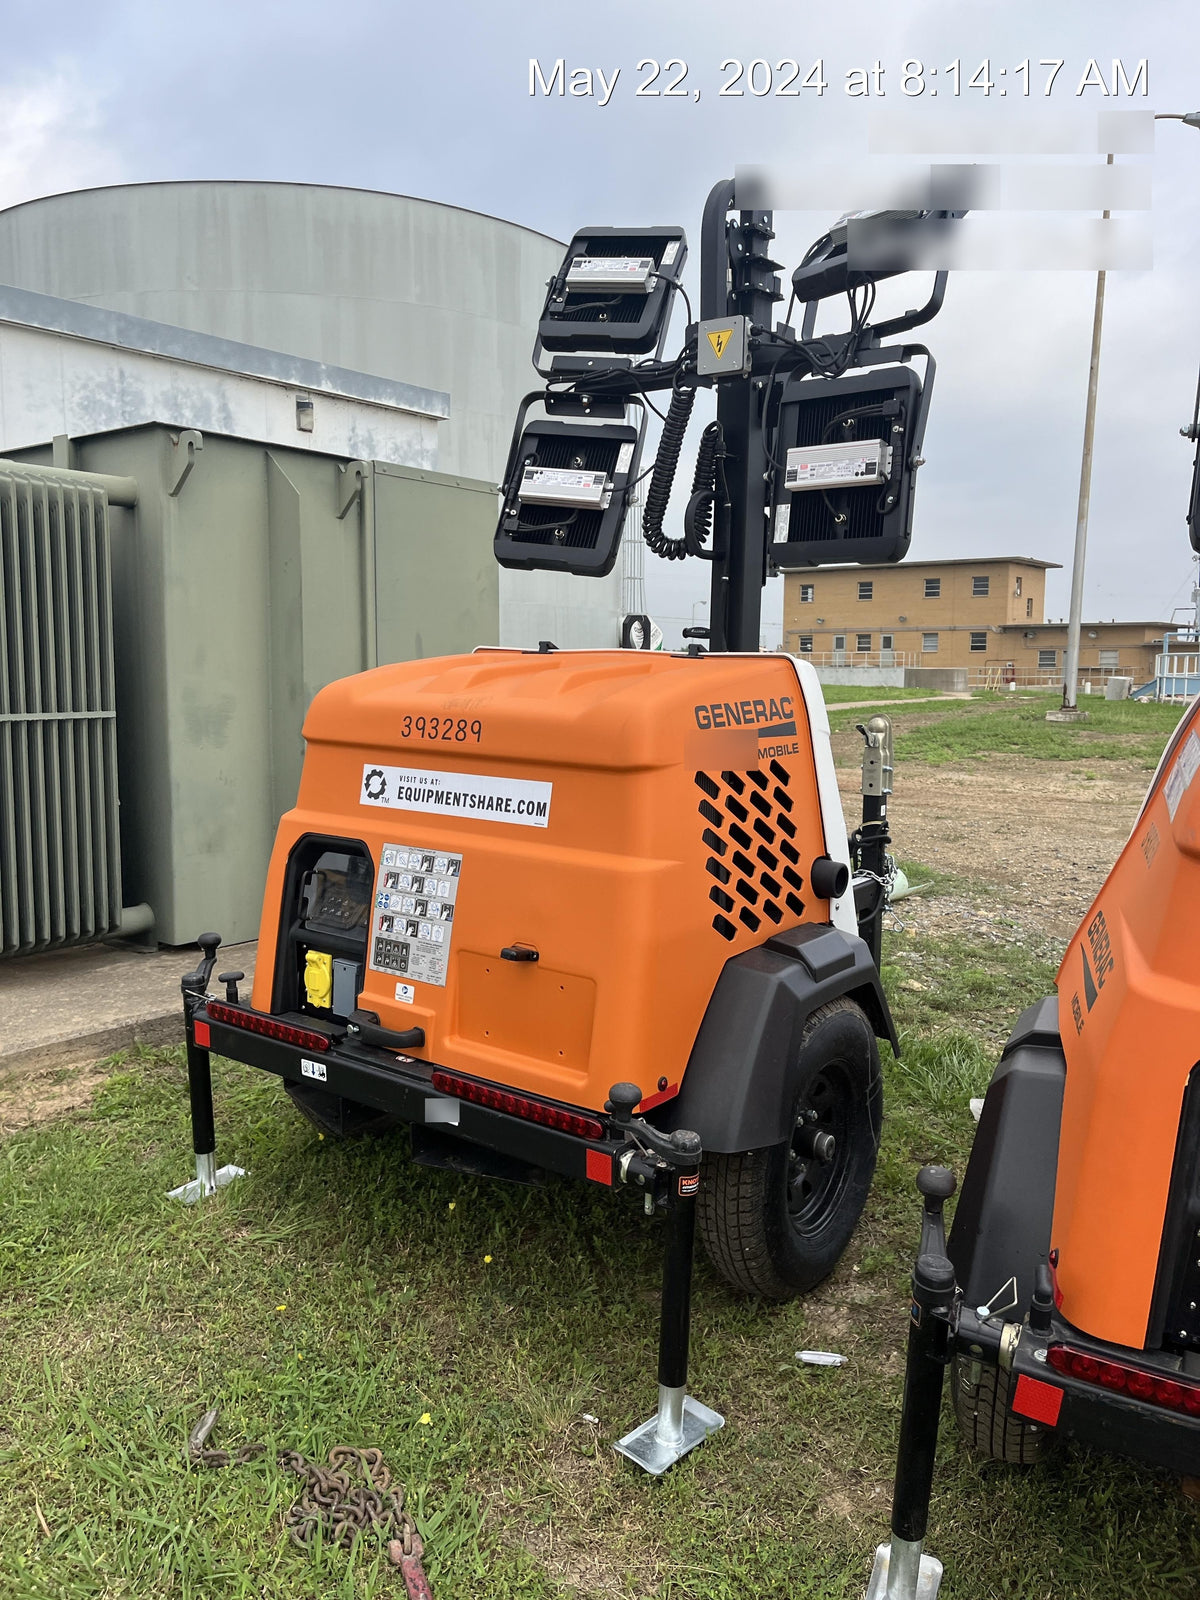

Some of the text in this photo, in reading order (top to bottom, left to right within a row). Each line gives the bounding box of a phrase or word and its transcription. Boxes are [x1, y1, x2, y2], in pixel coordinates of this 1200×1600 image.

[694, 696, 794, 730] GENERAC
[401, 715, 482, 743] 393289
[757, 743, 800, 760] MOBILE
[399, 775, 442, 786] VISIT US AT:
[397, 786, 548, 817] EQUIPMENTSHARE.COM
[1087, 910, 1115, 990] GENERAC
